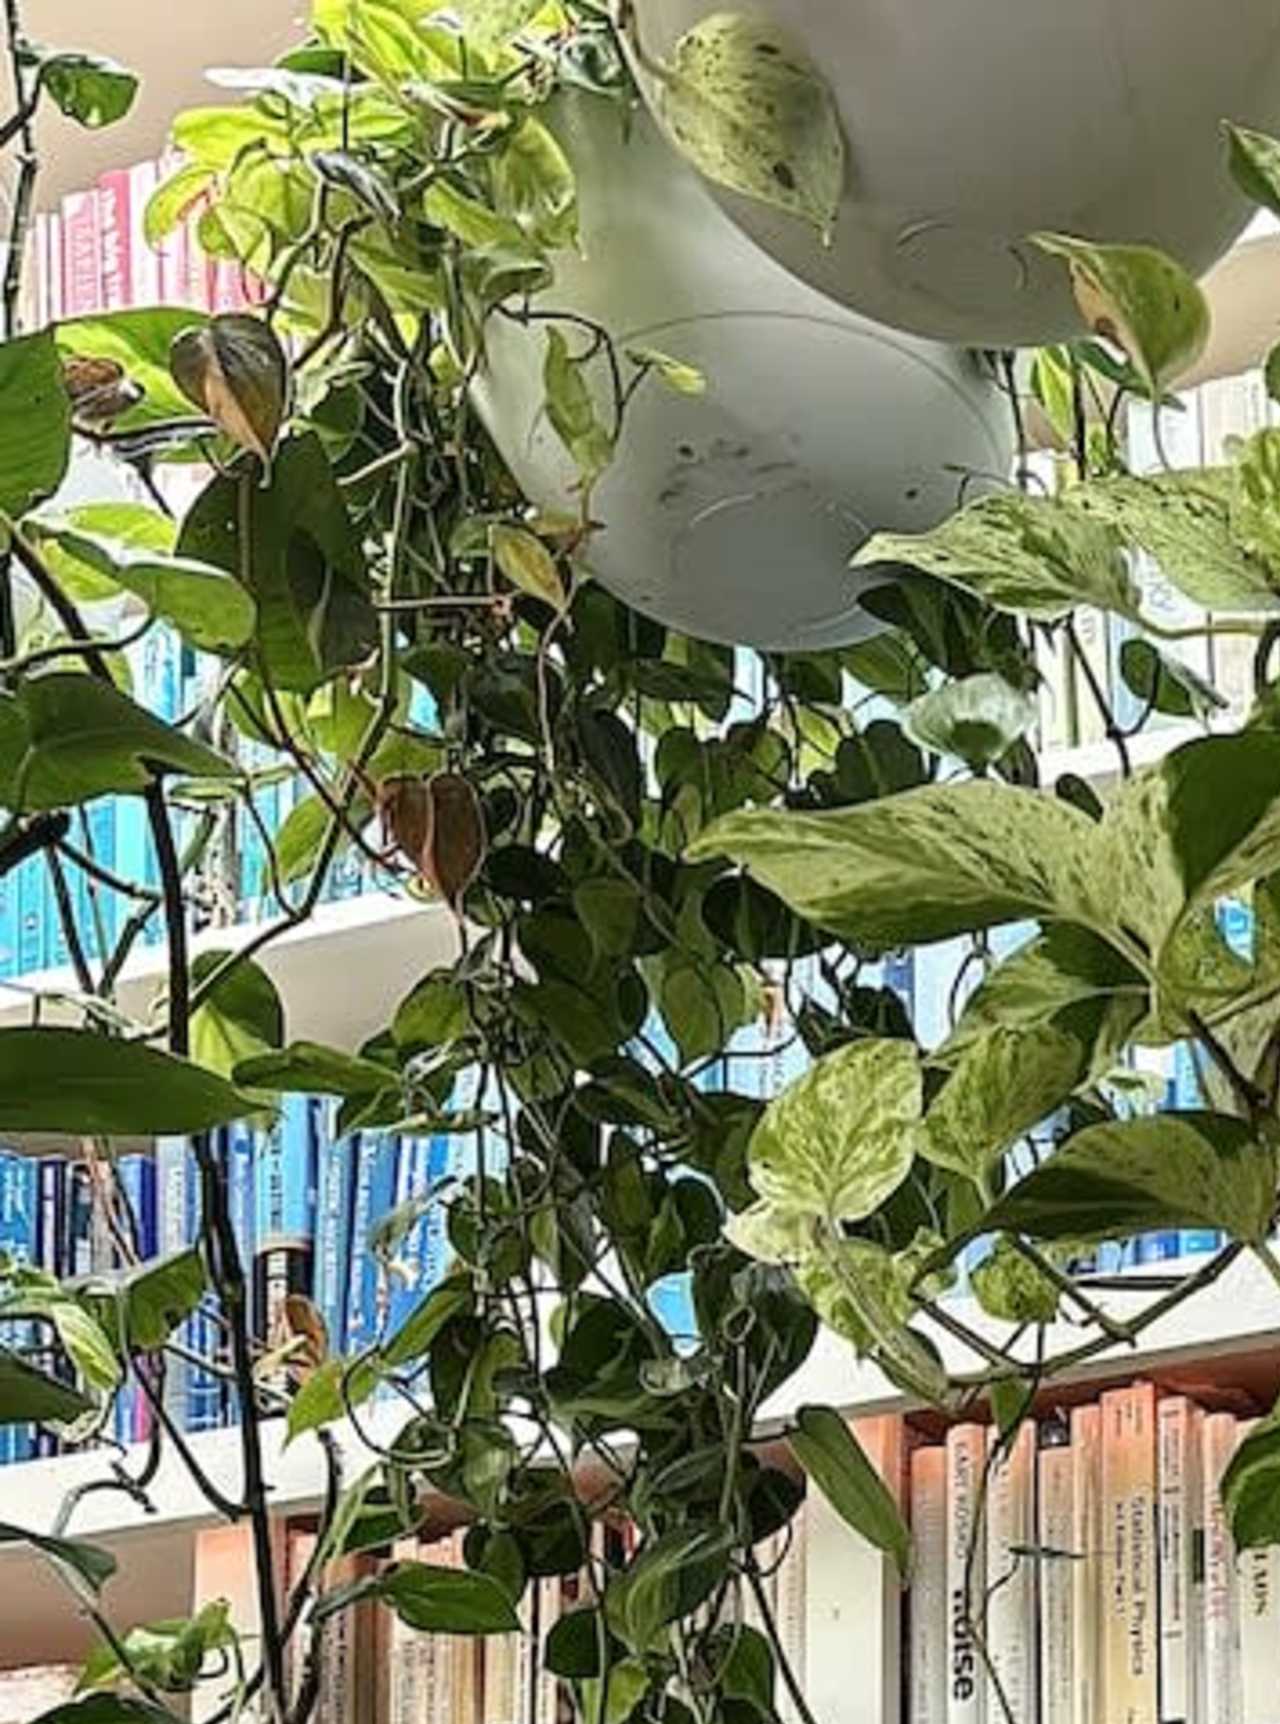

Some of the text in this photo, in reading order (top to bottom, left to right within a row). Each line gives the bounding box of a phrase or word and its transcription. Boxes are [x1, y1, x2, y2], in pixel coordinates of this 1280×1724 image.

[951, 1589, 977, 1702] noise
[1131, 1496, 1148, 1677] Statistical Physics
